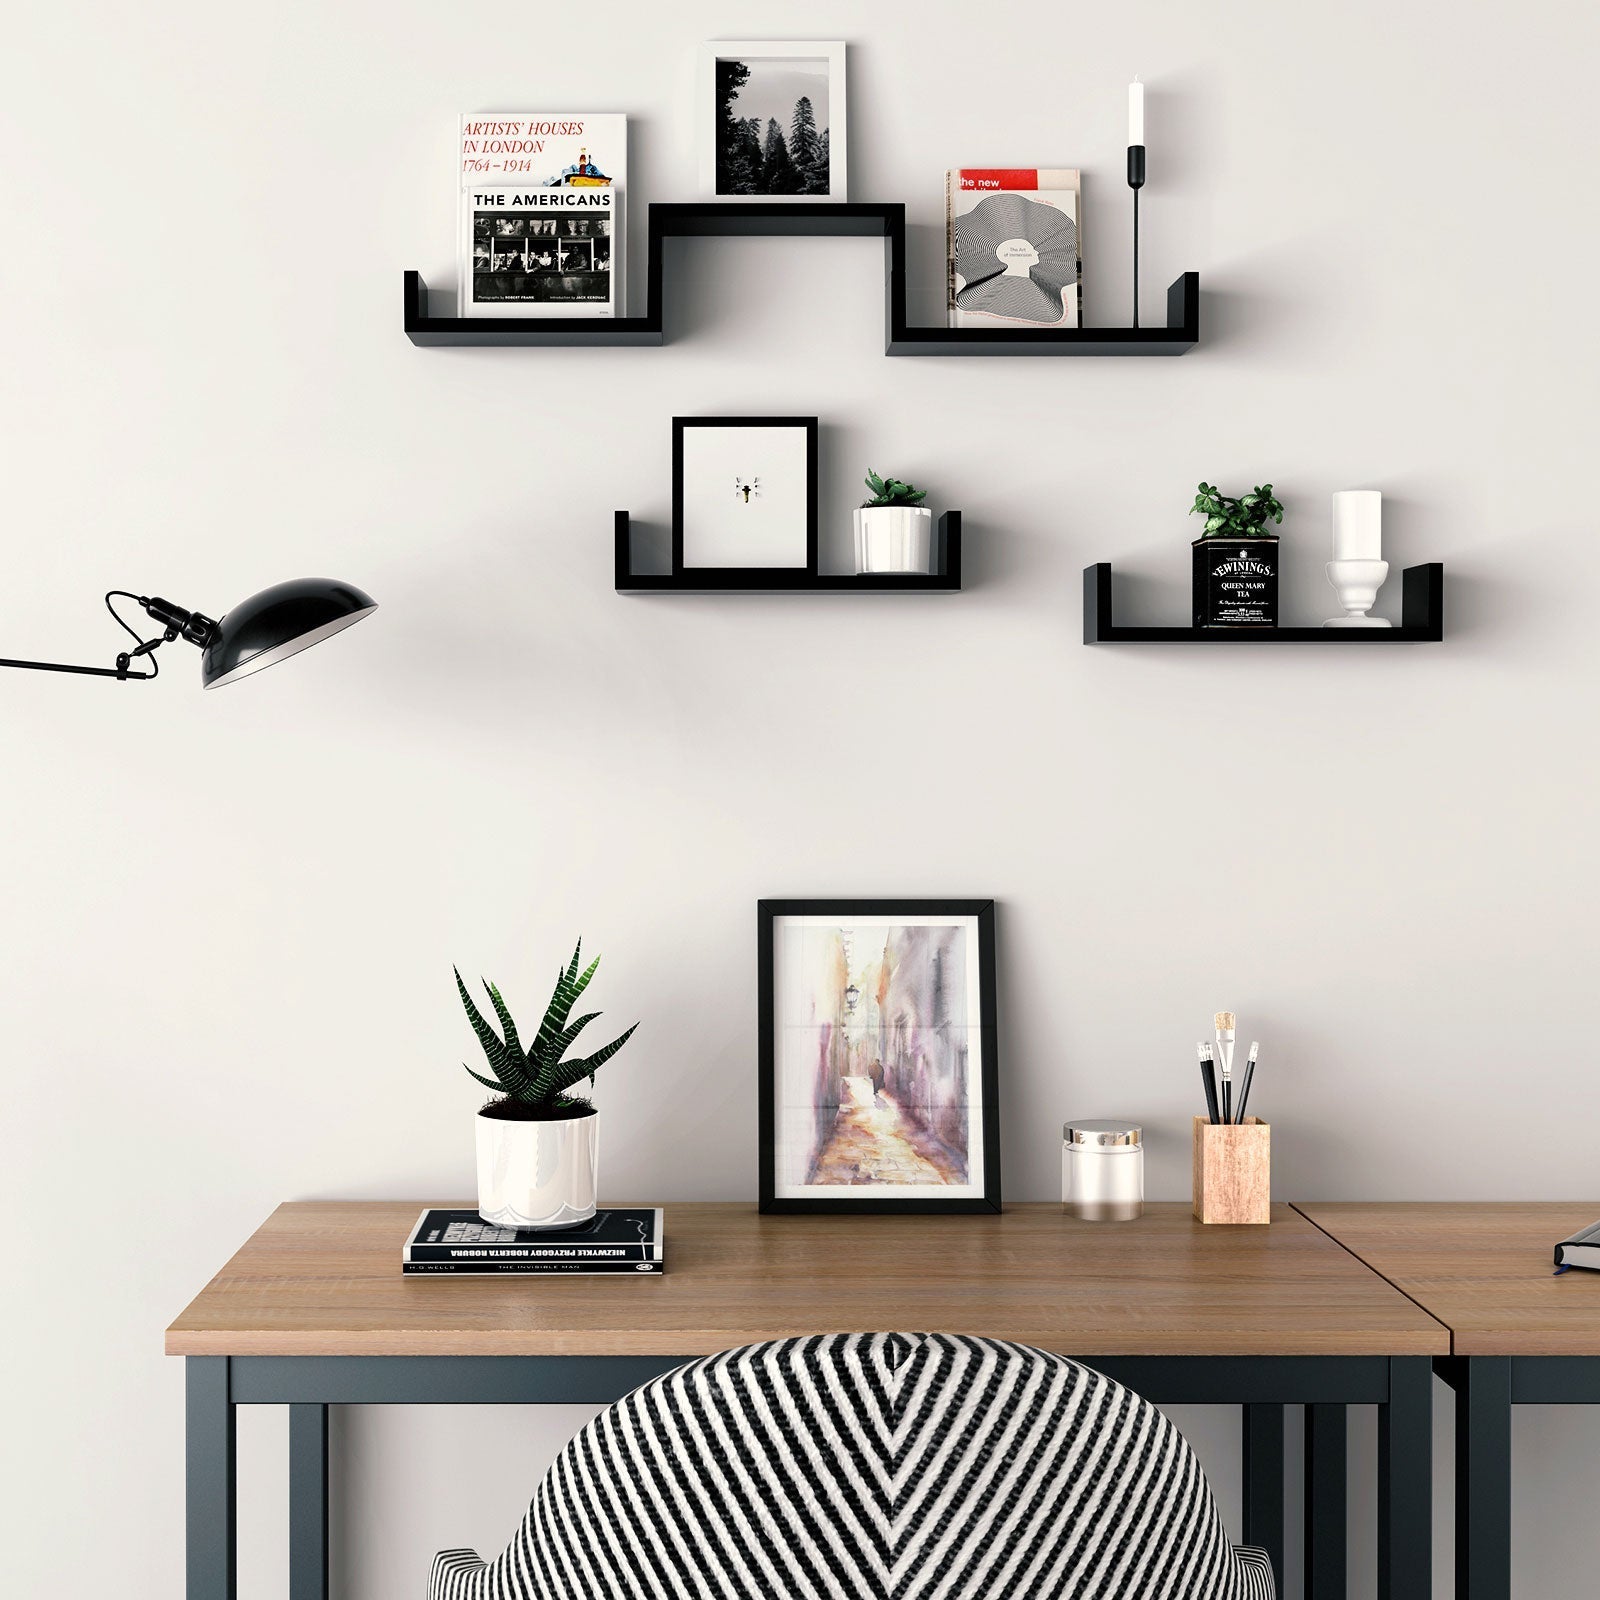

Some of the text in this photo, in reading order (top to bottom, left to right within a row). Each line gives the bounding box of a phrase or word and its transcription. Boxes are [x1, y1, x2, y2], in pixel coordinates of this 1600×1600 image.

[463, 122, 584, 136] ARTISTS’ HOUSES
[462, 140, 545, 154] IN LONDON
[959, 177, 1000, 187] the new
[473, 194, 611, 206] THE AMERICANS
[1221, 582, 1244, 591] QUEEN
[1236, 590, 1250, 598] TEA
[450, 1249, 488, 1257] ROBURA
[488, 1249, 529, 1257] ROBERTA
[530, 1249, 576, 1257] PRZYGODY
